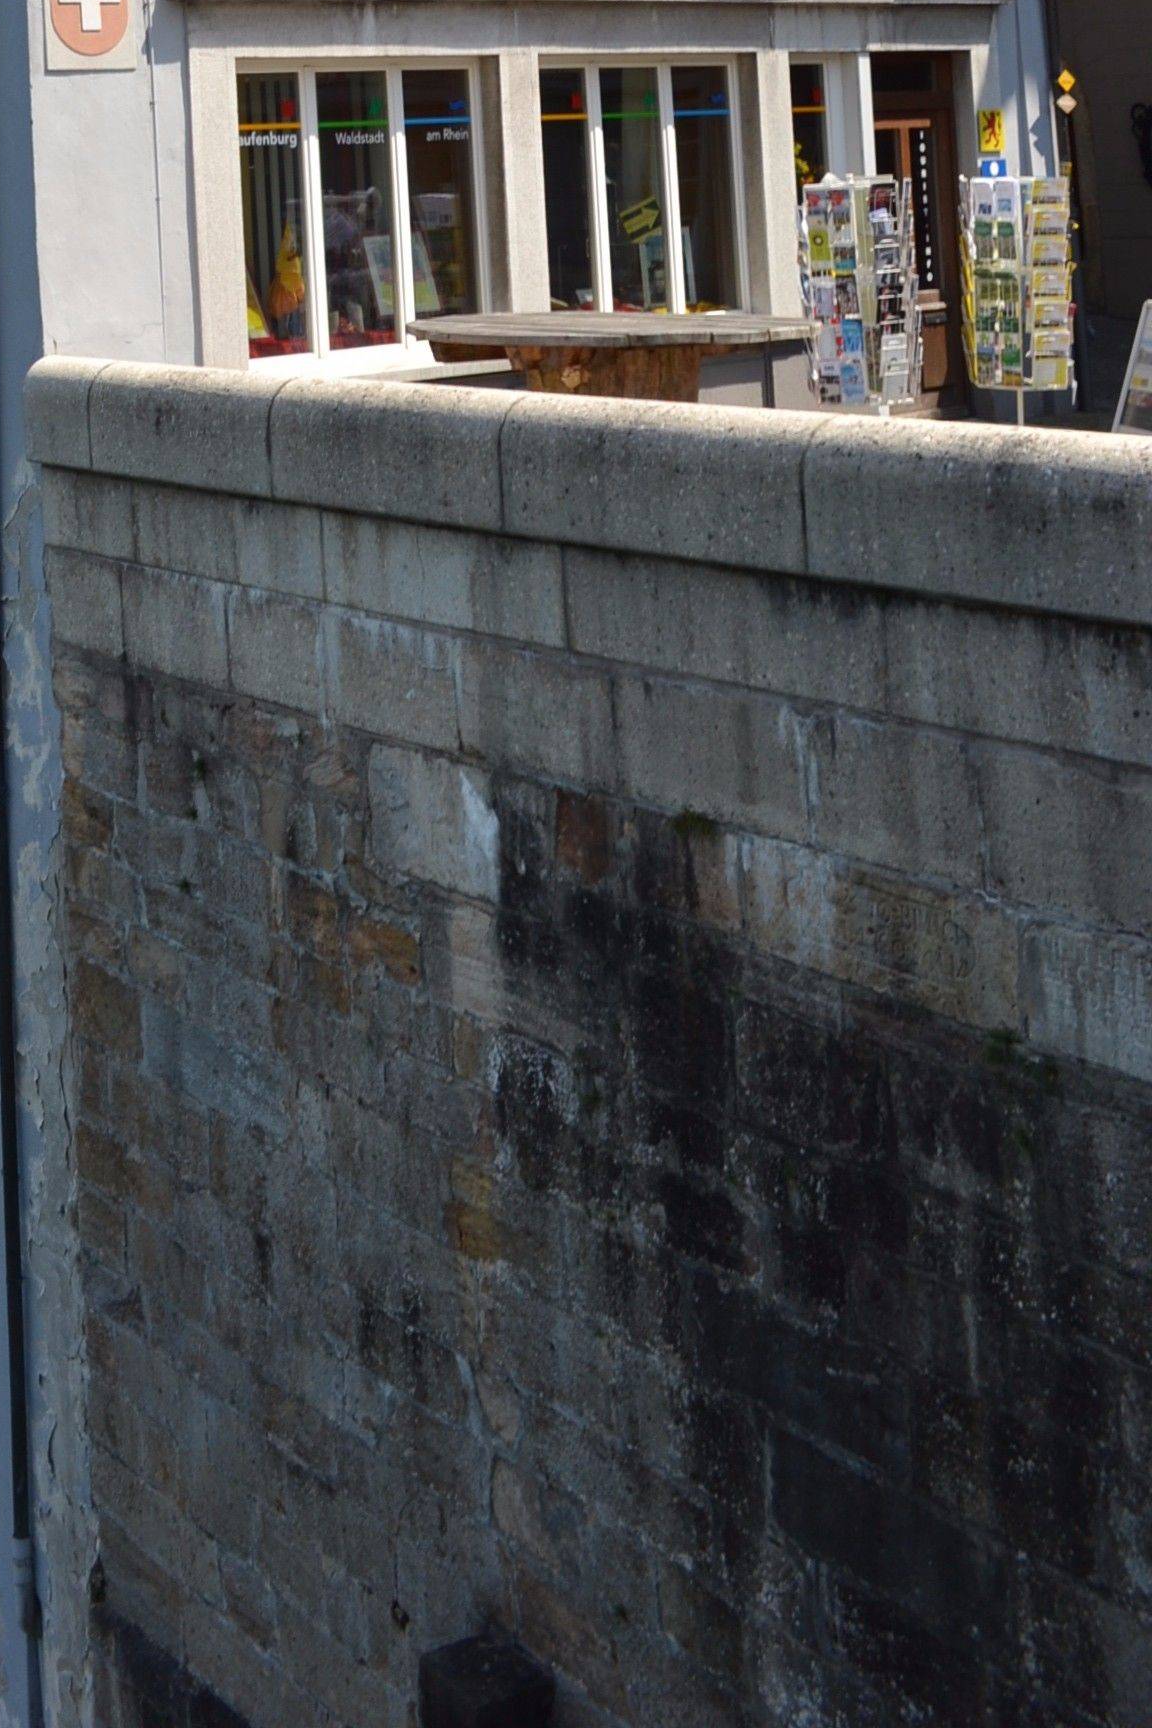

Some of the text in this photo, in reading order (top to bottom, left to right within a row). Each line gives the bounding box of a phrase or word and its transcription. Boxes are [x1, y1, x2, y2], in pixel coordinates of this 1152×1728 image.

[240, 131, 298, 148] aufenburg
[335, 131, 385, 145] Waldstadt
[426, 128, 469, 141] am Rhein
